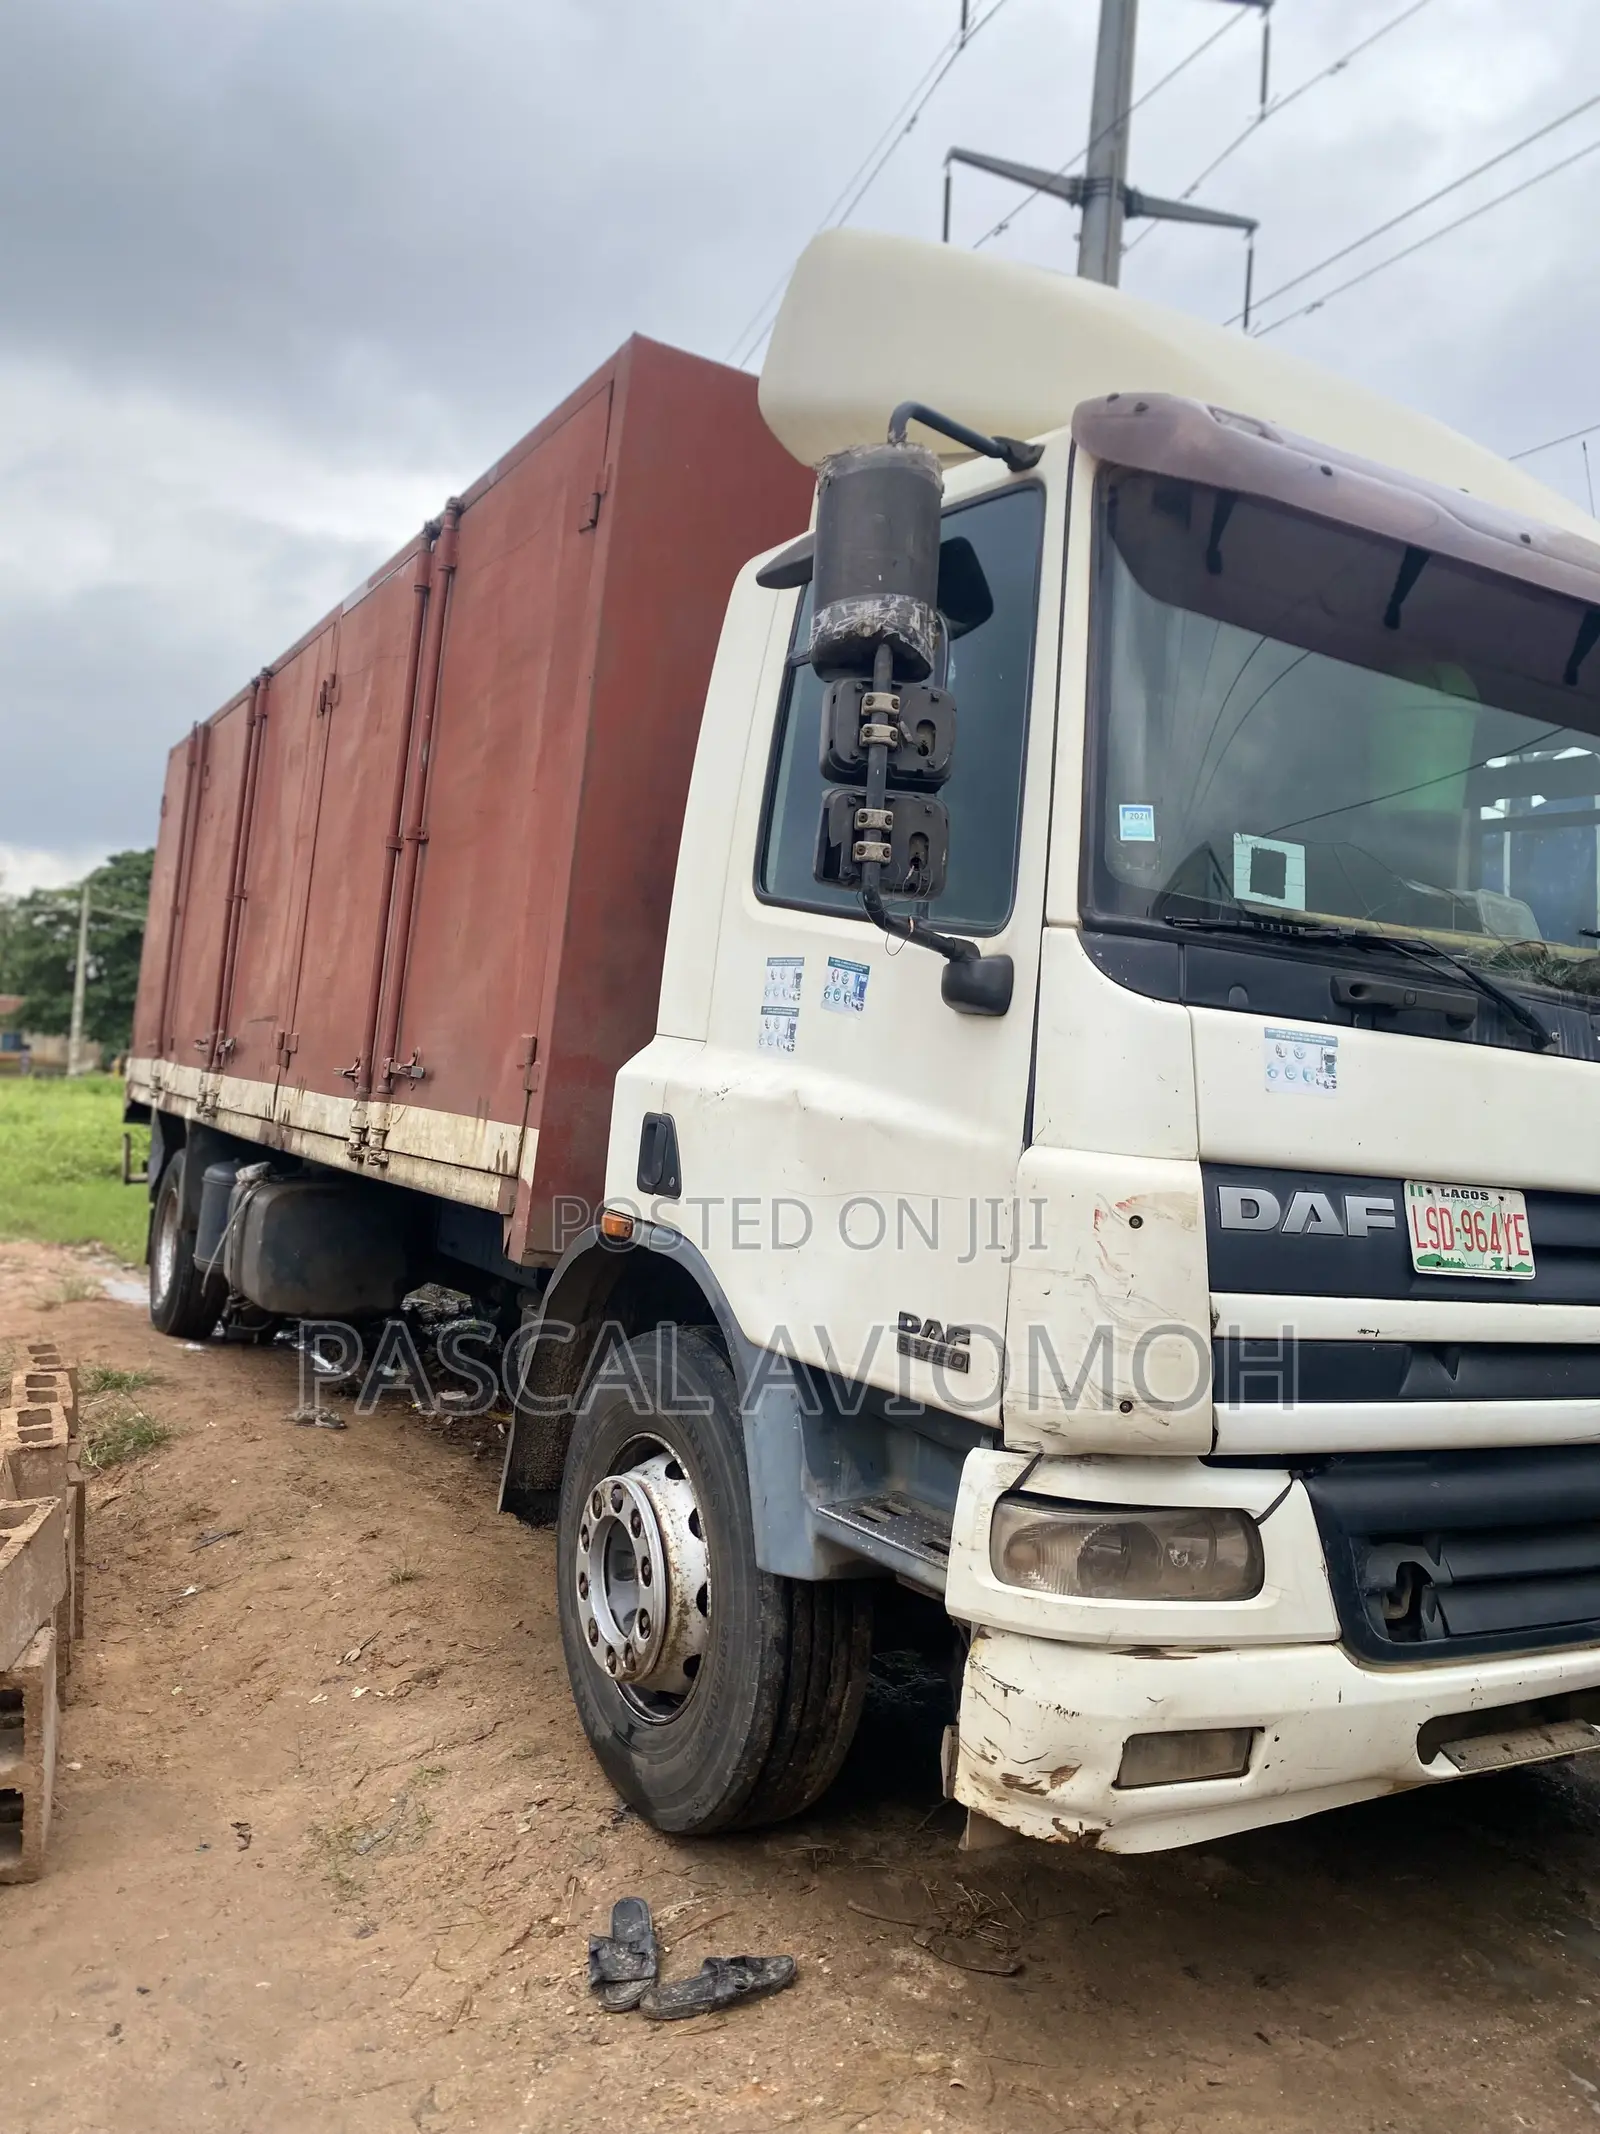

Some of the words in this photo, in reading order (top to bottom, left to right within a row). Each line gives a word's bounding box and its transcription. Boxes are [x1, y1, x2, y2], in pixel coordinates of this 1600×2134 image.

[1217, 1186, 1396, 1237] DAF
[1440, 1188, 1489, 1200] LAGOS
[898, 1311, 970, 1346] DAF
